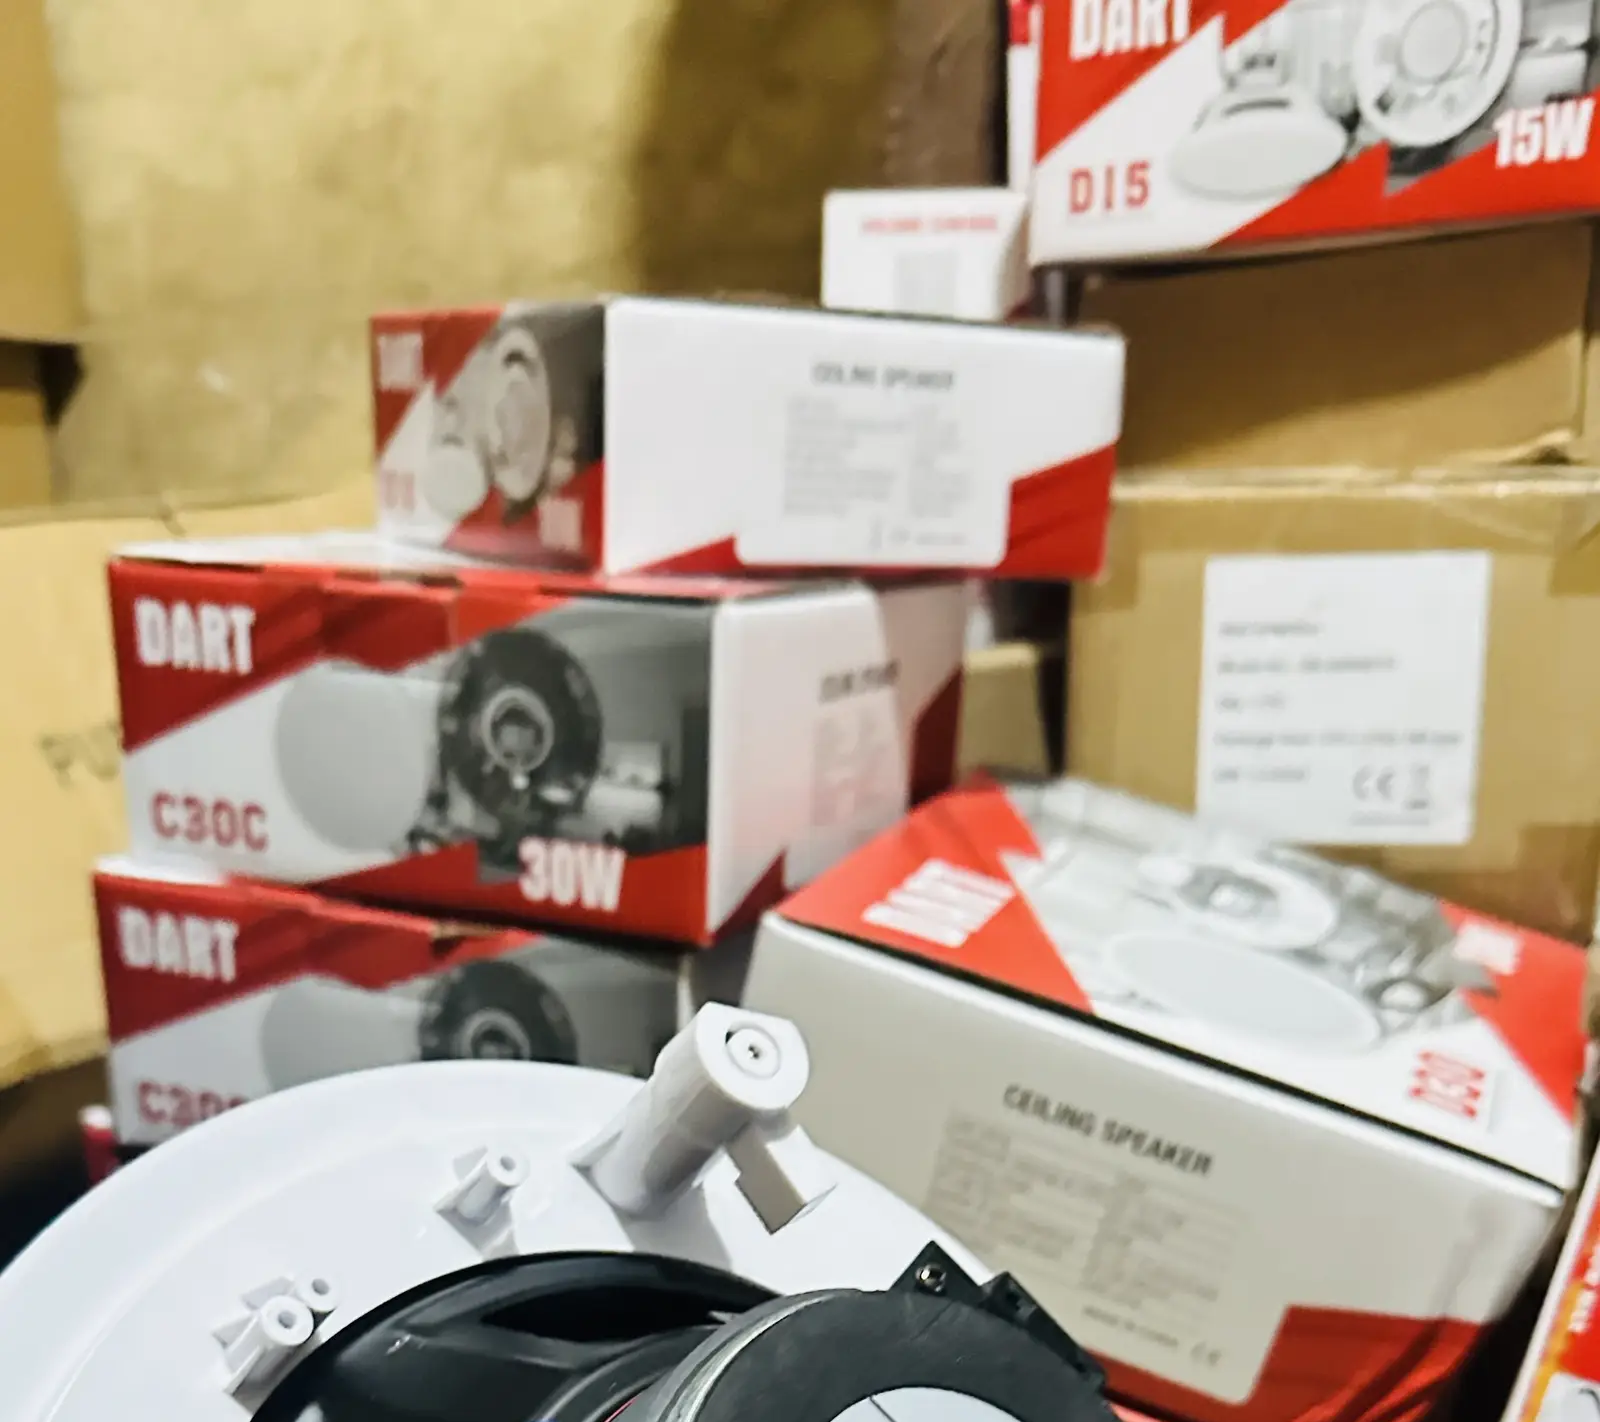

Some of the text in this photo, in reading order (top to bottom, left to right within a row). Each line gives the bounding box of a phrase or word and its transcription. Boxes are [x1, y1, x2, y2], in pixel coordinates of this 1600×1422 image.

[1069, 0, 1190, 60] DART
[1492, 97, 1595, 168] 15W
[134, 597, 256, 675] DART
[152, 791, 267, 851] C30C
[518, 836, 627, 913] 30W
[118, 904, 238, 983] DART
[137, 1079, 248, 1127] C30
[1102, 1119, 1213, 1177] SPEAKER
